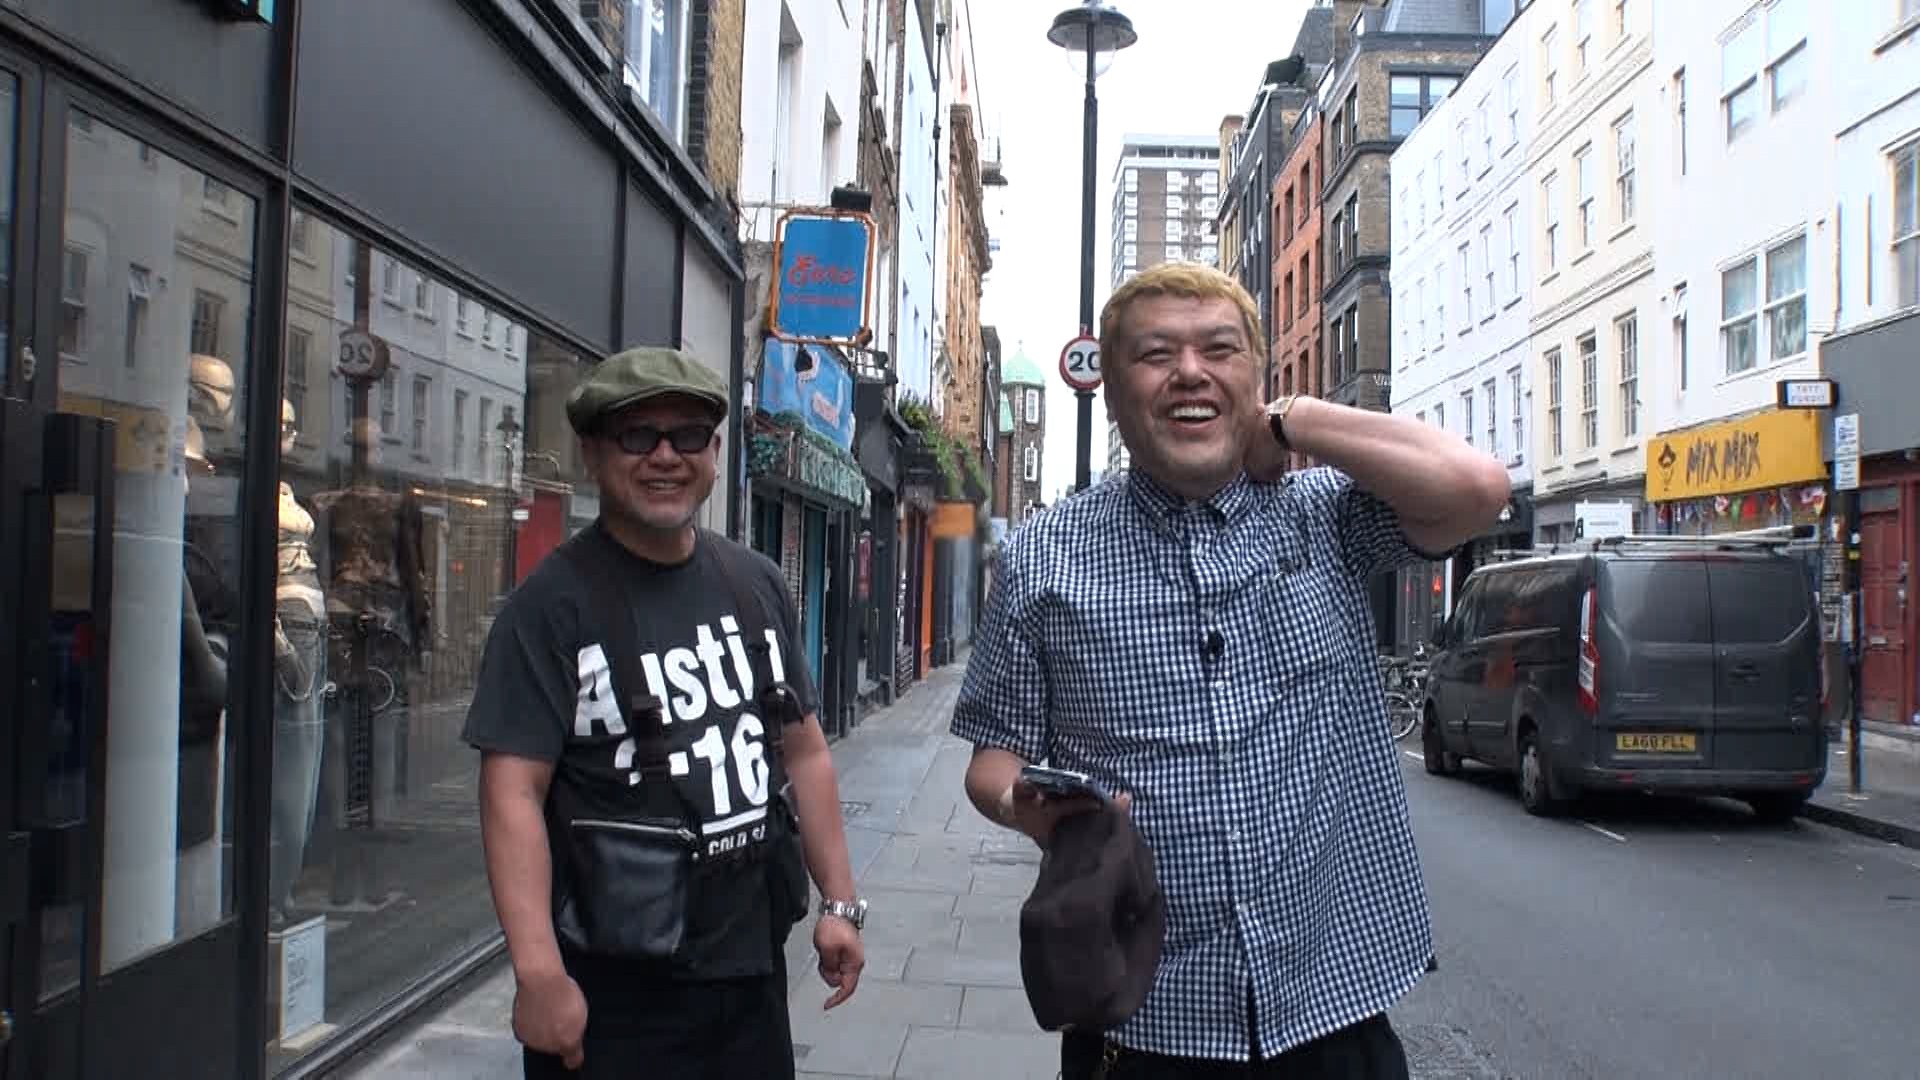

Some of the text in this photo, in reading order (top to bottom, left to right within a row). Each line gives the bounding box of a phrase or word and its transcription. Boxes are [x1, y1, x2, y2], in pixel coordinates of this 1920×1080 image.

[1068, 350, 1103, 372] 20
[1685, 429, 1761, 487] MIX MAX
